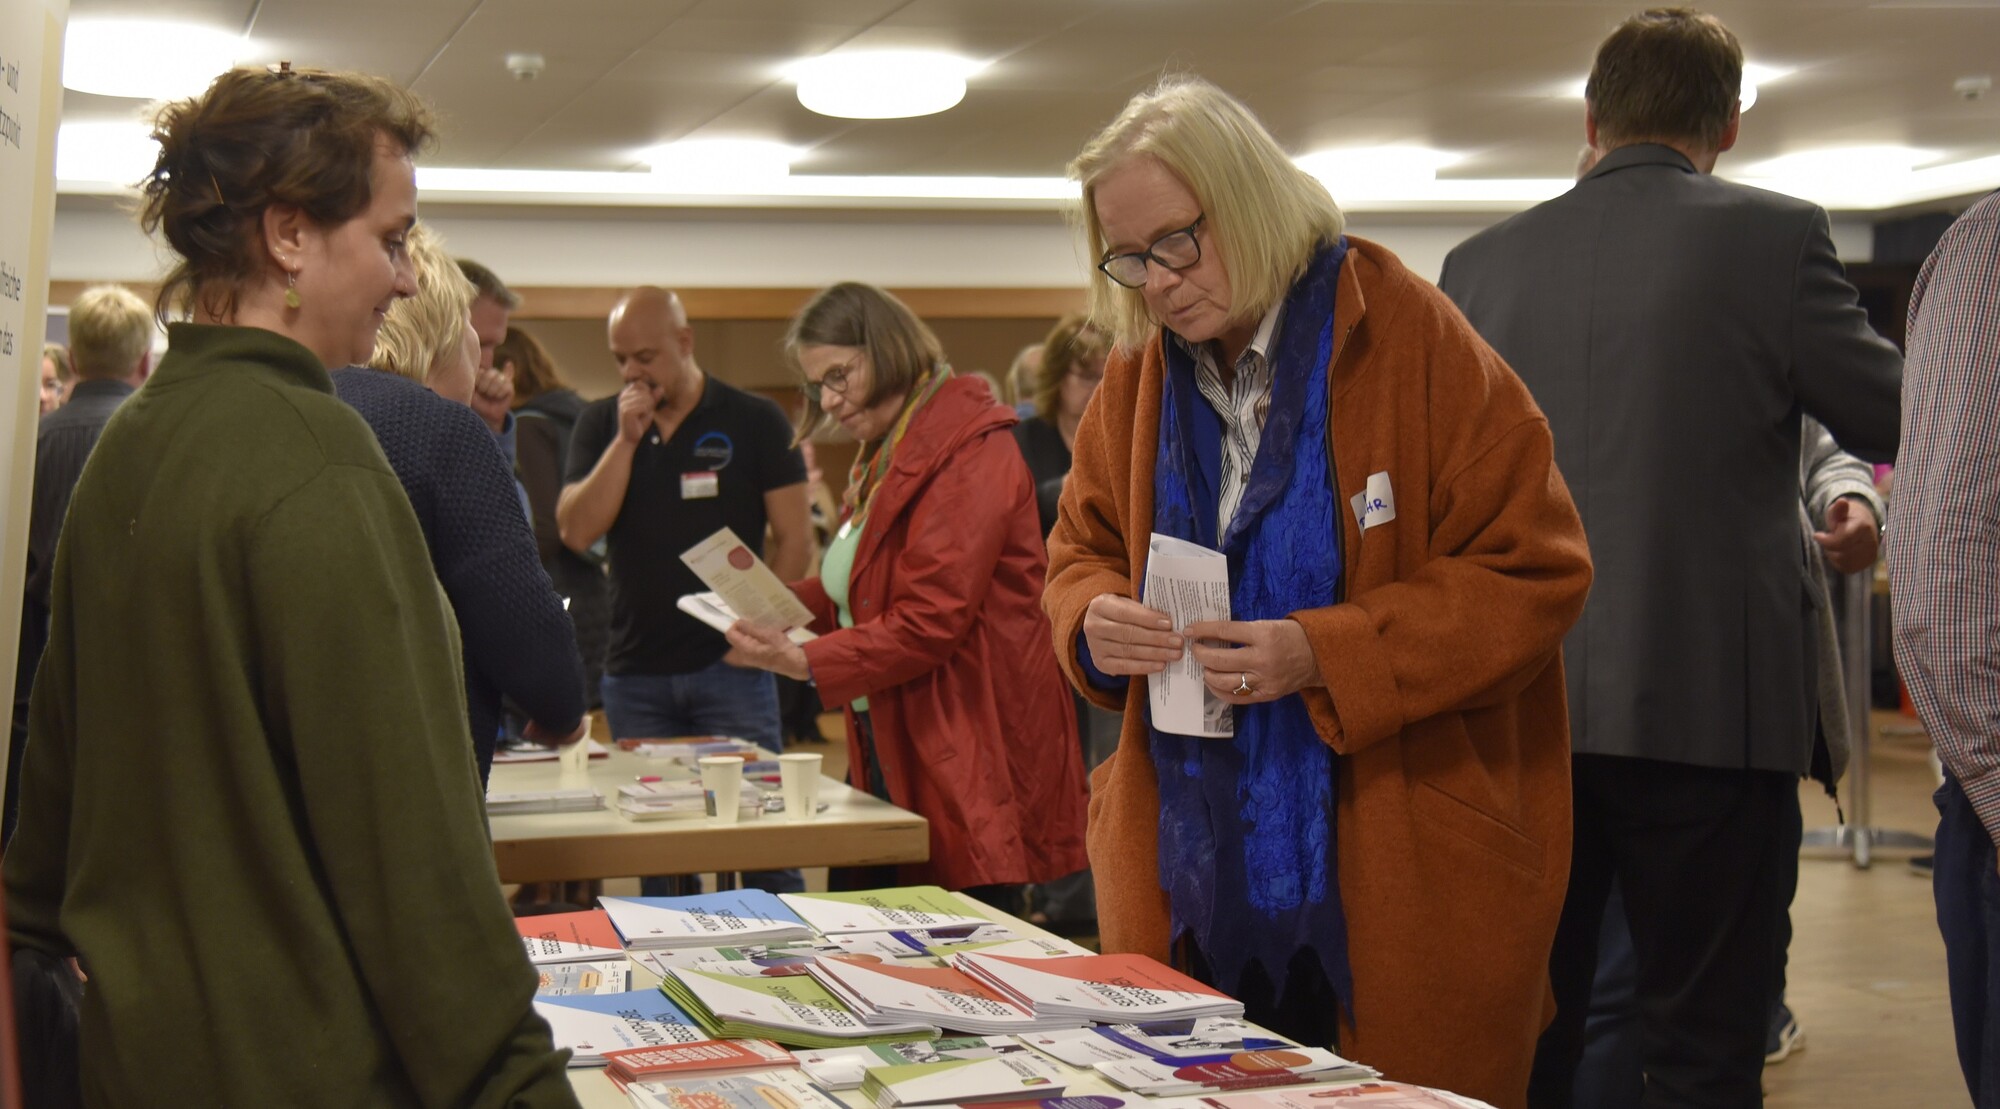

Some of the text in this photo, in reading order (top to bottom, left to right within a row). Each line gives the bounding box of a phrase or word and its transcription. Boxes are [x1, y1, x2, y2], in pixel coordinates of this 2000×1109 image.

[7, 60, 19, 94] und
[3, 322, 13, 356] das
[686, 907, 723, 931] HOMOPHOBIE
[713, 908, 747, 930] BEGEGNEN
[899, 904, 937, 925] BEGEGNEN
[767, 985, 827, 1027] ANTISEMITISMUS
[930, 986, 985, 1016] RASSISMUS
[962, 988, 1012, 1016] BEGEGNEN
[1083, 981, 1139, 1007] SEXISMUS
[1106, 977, 1167, 1006] BEGEGNEN
[617, 1009, 668, 1046] HOMOPHOBIE
[651, 1012, 698, 1043] BEGEGNEN
[808, 999, 856, 1027] BEGEGNEN
